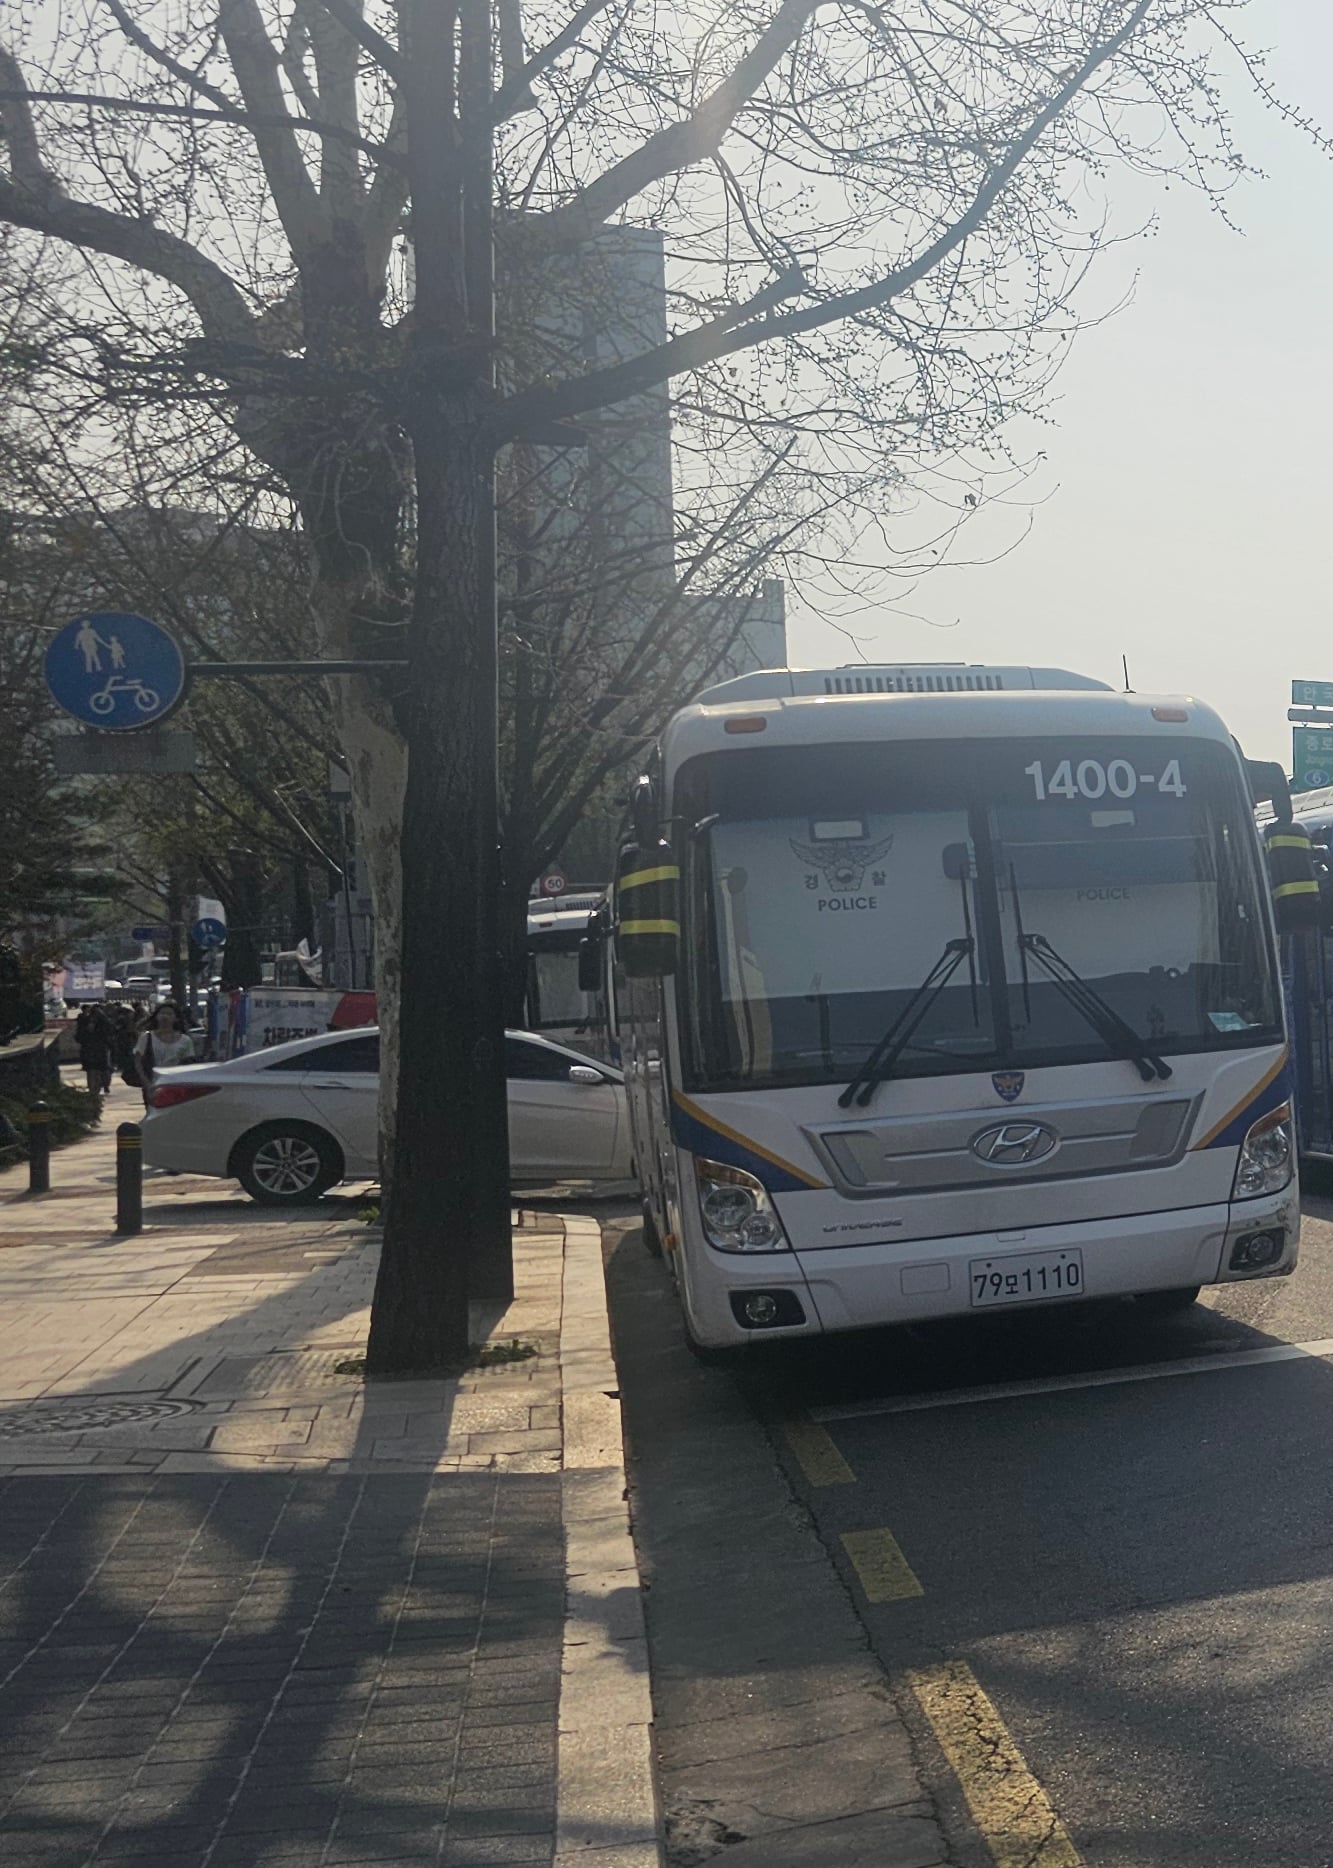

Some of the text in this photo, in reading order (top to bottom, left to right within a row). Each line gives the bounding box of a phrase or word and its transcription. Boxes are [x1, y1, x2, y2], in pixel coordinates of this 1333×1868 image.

[1025, 760, 1187, 800] 1400-4
[548, 879, 561, 889] 50
[804, 870, 886, 890] 경 찰
[1078, 887, 1131, 902] POLICE
[818, 897, 878, 912] POLICE
[973, 1262, 1079, 1299] 79모1110
